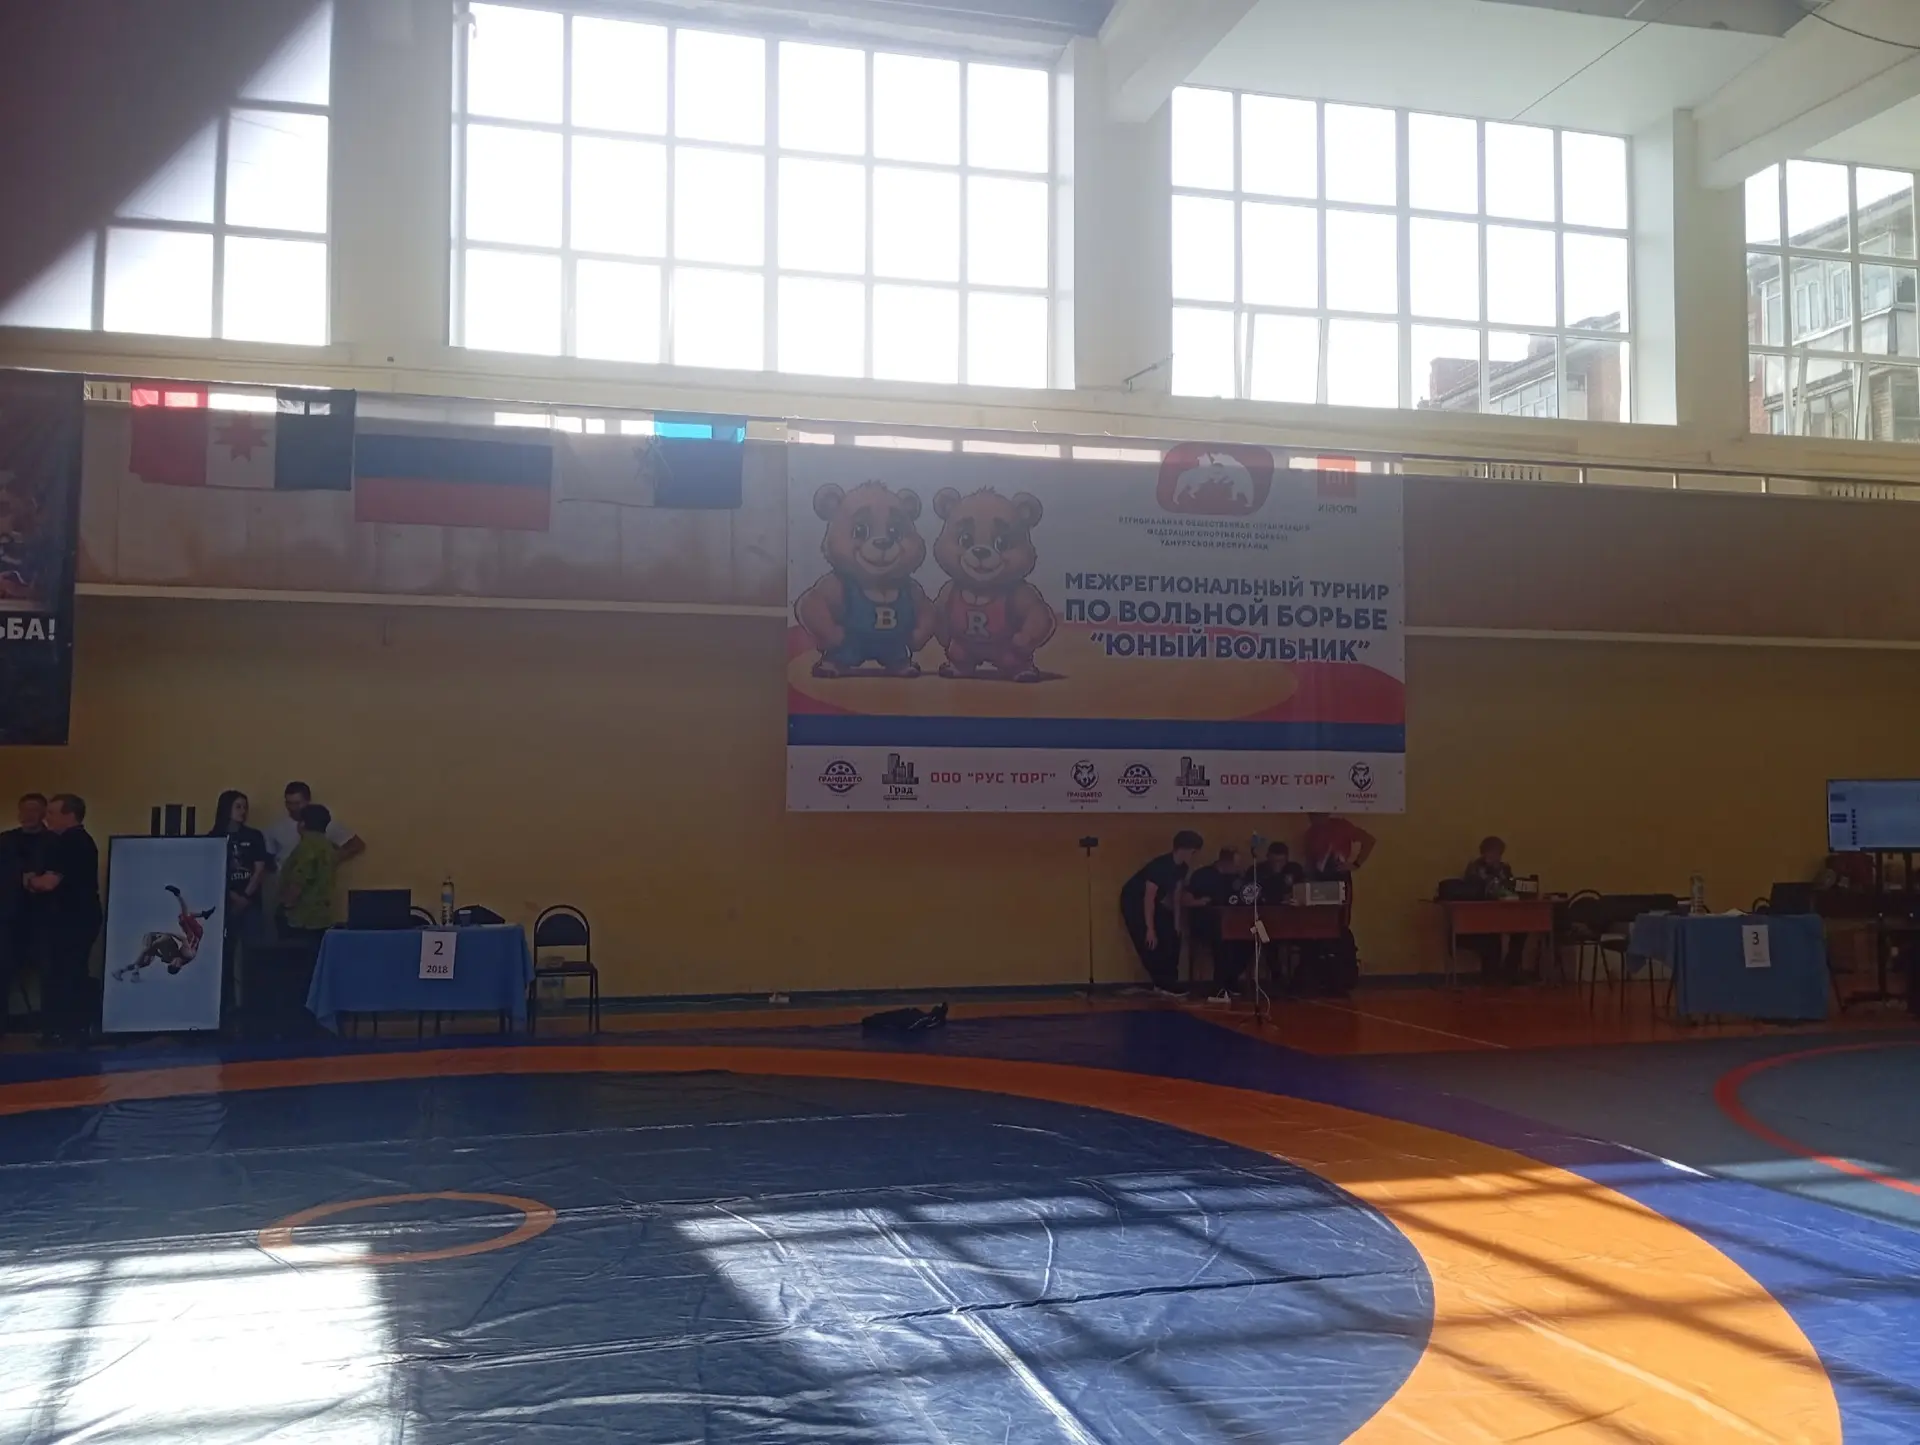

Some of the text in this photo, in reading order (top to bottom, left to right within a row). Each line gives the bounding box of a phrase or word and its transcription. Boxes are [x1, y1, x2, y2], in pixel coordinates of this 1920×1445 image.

[1065, 572, 1389, 601] МЕЖРЕГИОНАЛЬНЫЙ ТУРНИР
[1066, 597, 1388, 631] ПО ВОЛЬНОЙ БОРЬБЕ
[930, 772, 962, 784] ООО
[1220, 774, 1250, 785] ООО
[889, 785, 914, 796] Град
[1182, 786, 1205, 797] Град
[1751, 931, 1760, 946] 3
[433, 940, 444, 956] 2
[426, 965, 449, 974] 2018
